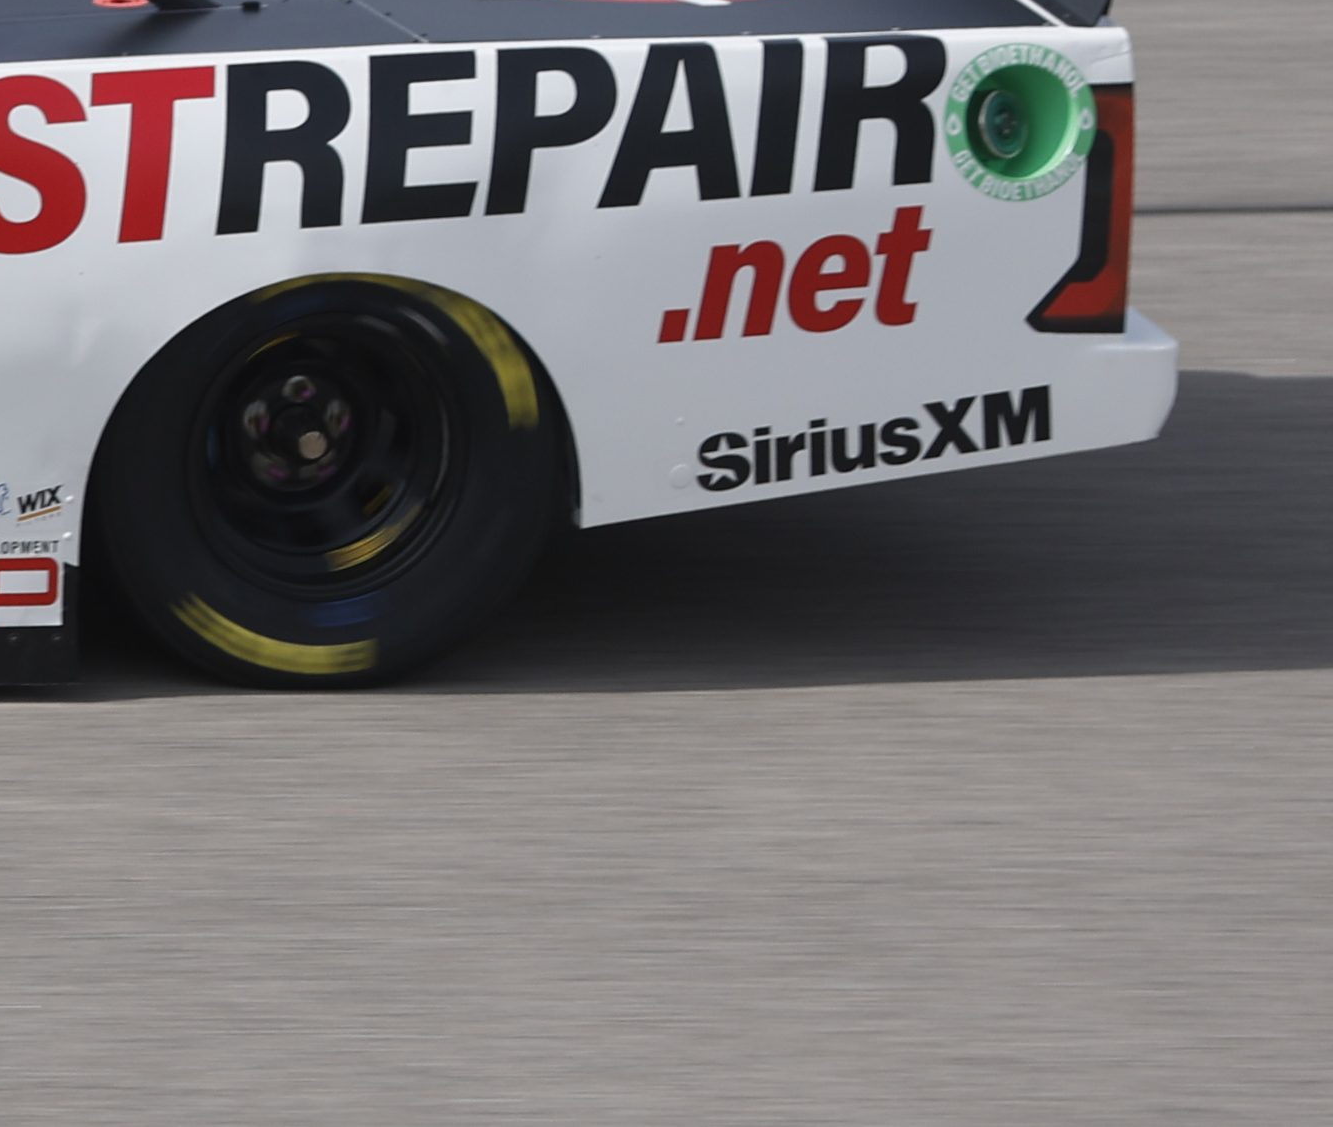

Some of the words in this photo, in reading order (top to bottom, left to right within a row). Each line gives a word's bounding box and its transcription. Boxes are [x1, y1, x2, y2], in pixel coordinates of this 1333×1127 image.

[657, 205, 933, 344] .net
[696, 385, 1052, 492] SiriusXM
[17, 484, 64, 514] WIX
